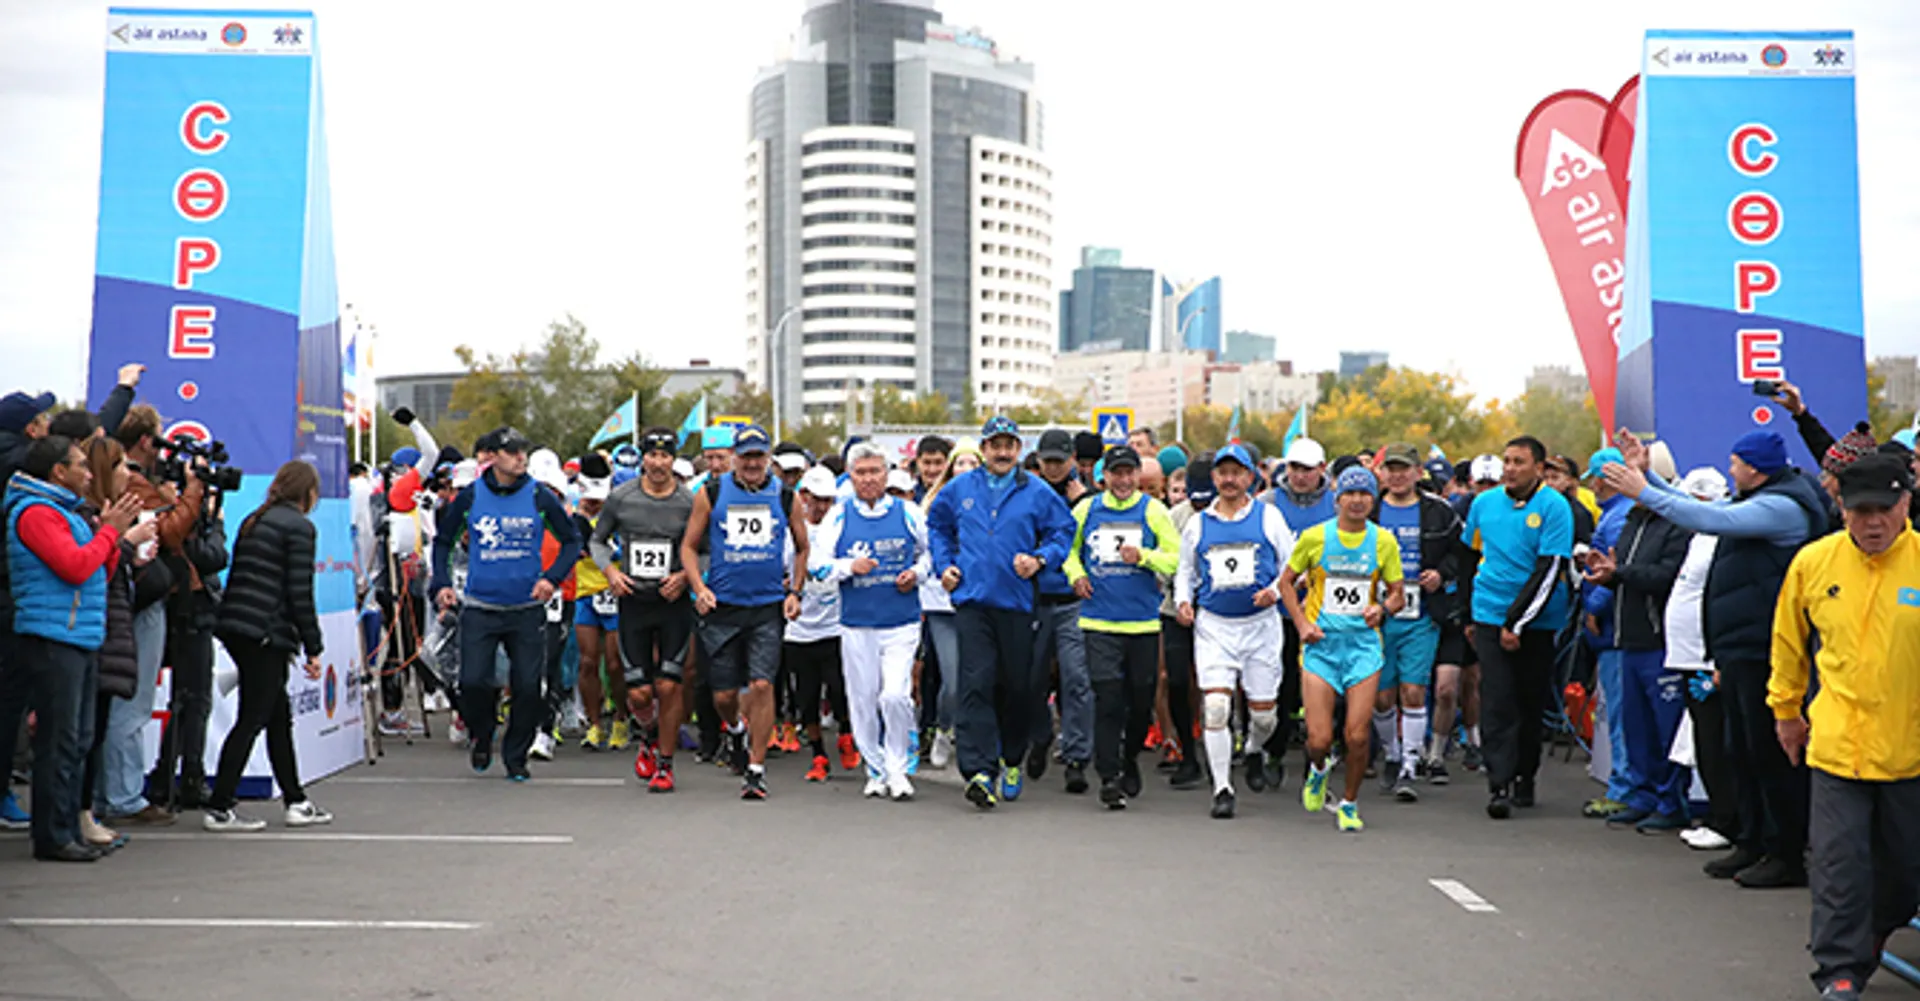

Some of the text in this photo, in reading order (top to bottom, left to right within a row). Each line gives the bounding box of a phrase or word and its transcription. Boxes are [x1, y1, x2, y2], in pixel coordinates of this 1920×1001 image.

[1697, 49, 1749, 64] astana
[1567, 191, 1616, 247] air
[737, 517, 763, 535] 70
[634, 549, 666, 568] 121
[1224, 557, 1238, 574] 9
[1333, 586, 1361, 605] 96
